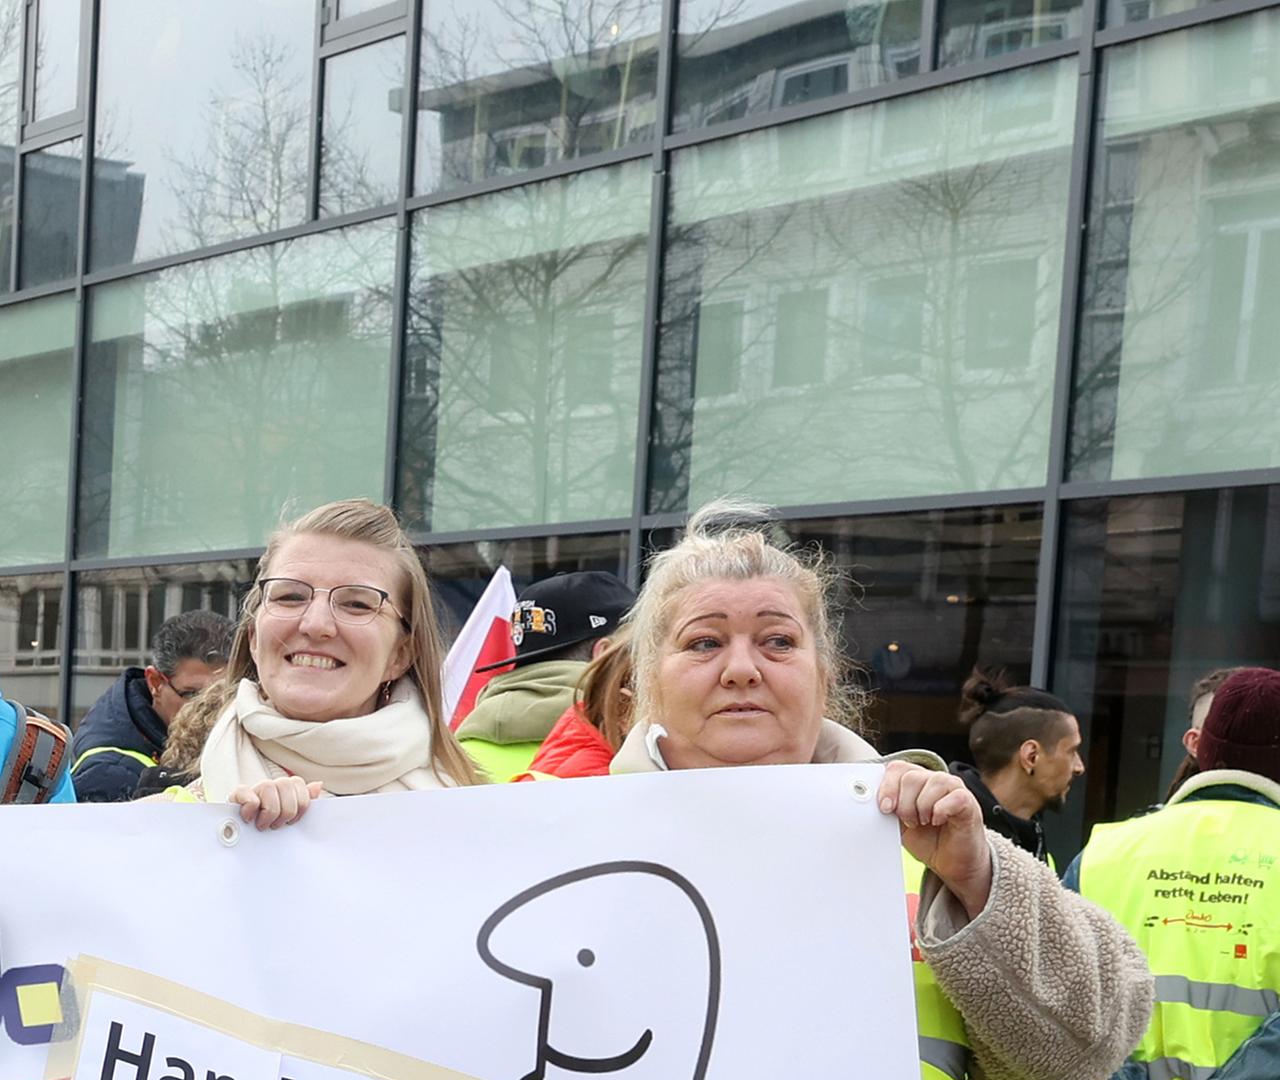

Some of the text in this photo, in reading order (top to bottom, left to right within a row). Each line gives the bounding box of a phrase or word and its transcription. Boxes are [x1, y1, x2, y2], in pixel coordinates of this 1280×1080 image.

[1146, 868, 1265, 890] Abstand halten
[1153, 886, 1250, 905] rettet Leben!
